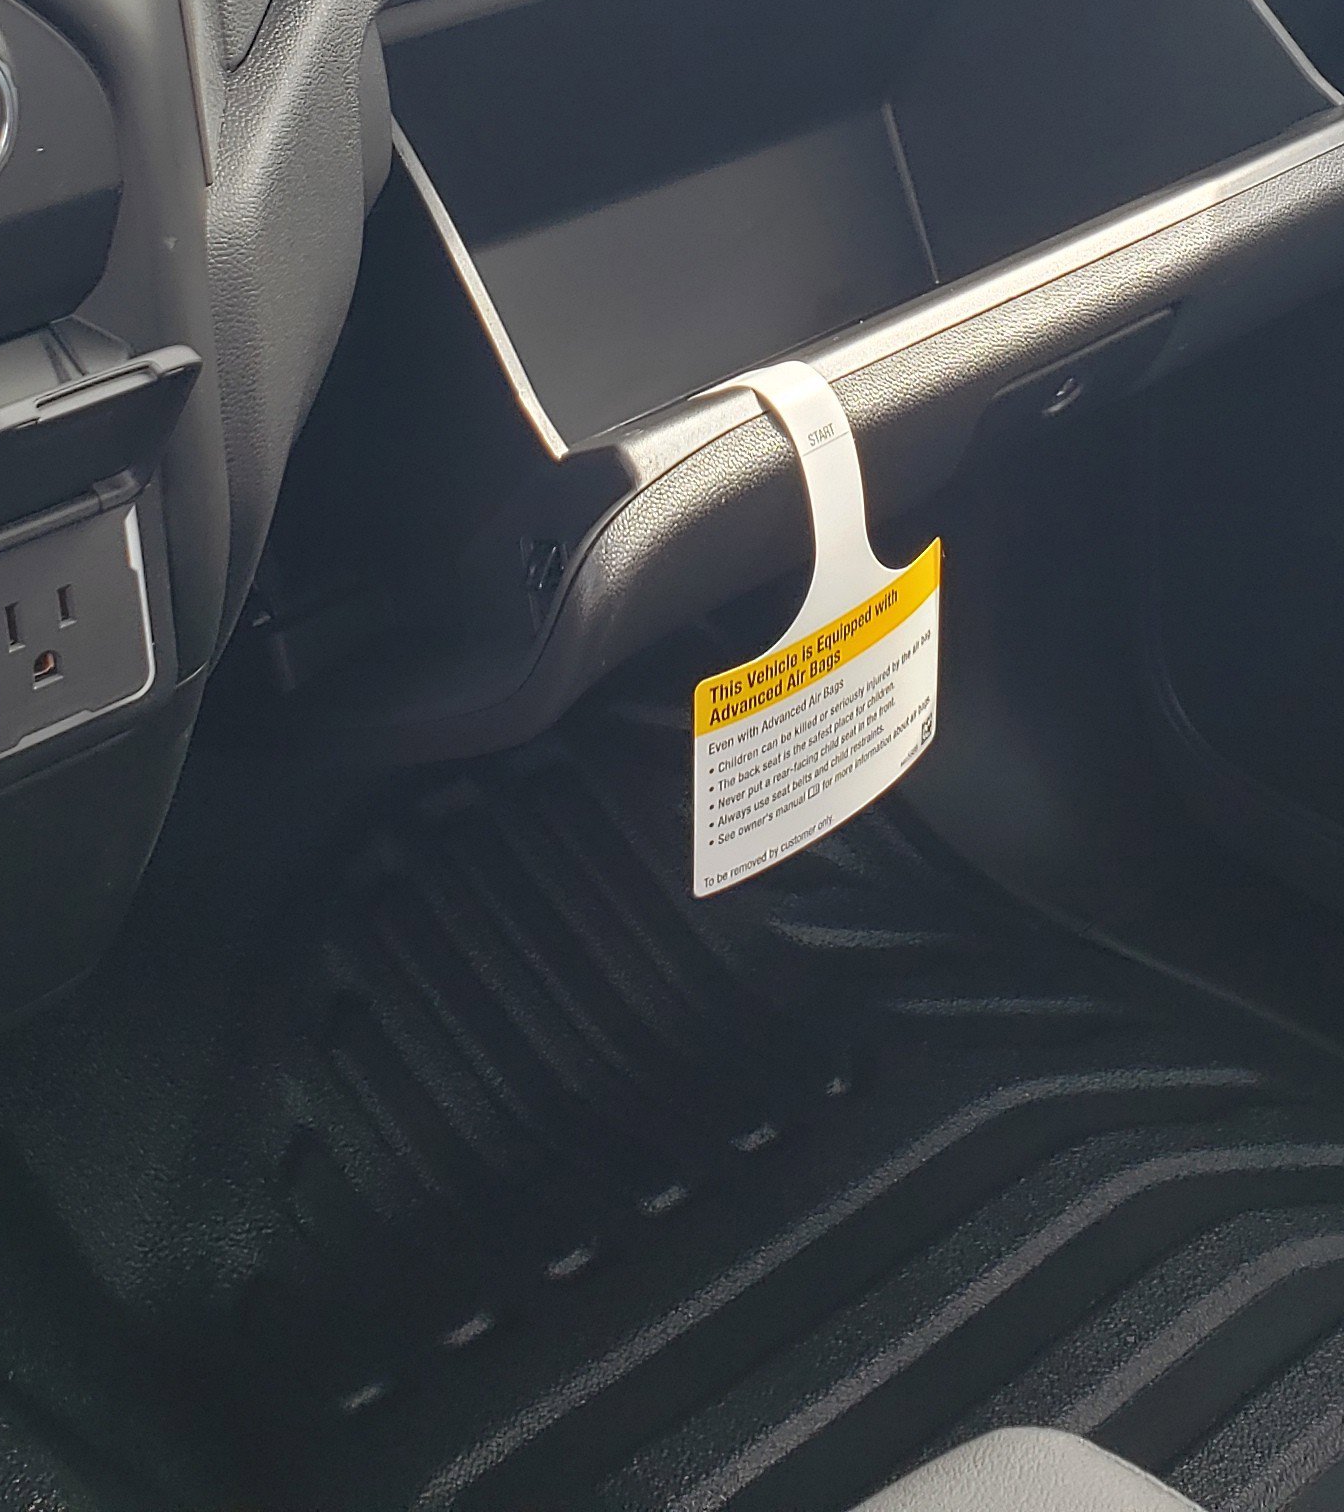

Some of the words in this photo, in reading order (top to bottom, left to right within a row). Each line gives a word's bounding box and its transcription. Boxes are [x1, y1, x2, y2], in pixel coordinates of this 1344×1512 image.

[807, 423, 835, 447] START
[709, 679, 783, 726] Advanced
[787, 669, 806, 691] Air
[810, 650, 840, 679] Bags
[710, 680, 742, 704] This
[747, 653, 797, 689] Vehicle
[802, 645, 813, 662] is
[817, 605, 871, 653] Equipped
[875, 589, 898, 617] with
[708, 737, 734, 755] Even
[737, 726, 759, 743] with
[761, 699, 806, 733] Advanced
[808, 693, 821, 708] Air
[823, 679, 844, 699] Bags
[718, 747, 759, 773] Children
[761, 737, 778, 754] can
[781, 731, 792, 744] be
[794, 716, 817, 736] killed
[819, 711, 828, 722] or
[830, 686, 864, 716] seriously
[866, 665, 890, 692] injured
[892, 659, 900, 673] by
[901, 650, 911, 664] the
[718, 777, 736, 792] The
[738, 765, 760, 782] back
[762, 753, 781, 771] seat
[783, 748, 791, 761] is
[793, 739, 806, 755] the
[808, 724, 833, 747] safest
[834, 710, 854, 736] place
[855, 702, 865, 717] for
[717, 805, 752, 828] Always
[754, 795, 769, 811] use
[772, 784, 791, 802] seat
[792, 769, 812, 788] belts
[814, 762, 829, 778] and
[830, 748, 849, 768] child
[718, 791, 746, 809] Never
[748, 782, 763, 799] put
[765, 778, 771, 788] a
[773, 750, 819, 784] rear-facing
[820, 736, 839, 756] child
[841, 725, 857, 744] seat
[858, 720, 865, 735] in
[866, 711, 877, 726] the
[718, 830, 736, 845] See
[738, 812, 774, 836] owner's
[775, 793, 806, 818] manual
[822, 776, 833, 791] for
[834, 763, 853, 783] more
[854, 734, 892, 769] information
[893, 716, 910, 739] about
[704, 877, 715, 889] To
[716, 869, 728, 883] be
[730, 851, 767, 877] removed
[769, 846, 779, 860] by
[781, 826, 816, 853] customer
